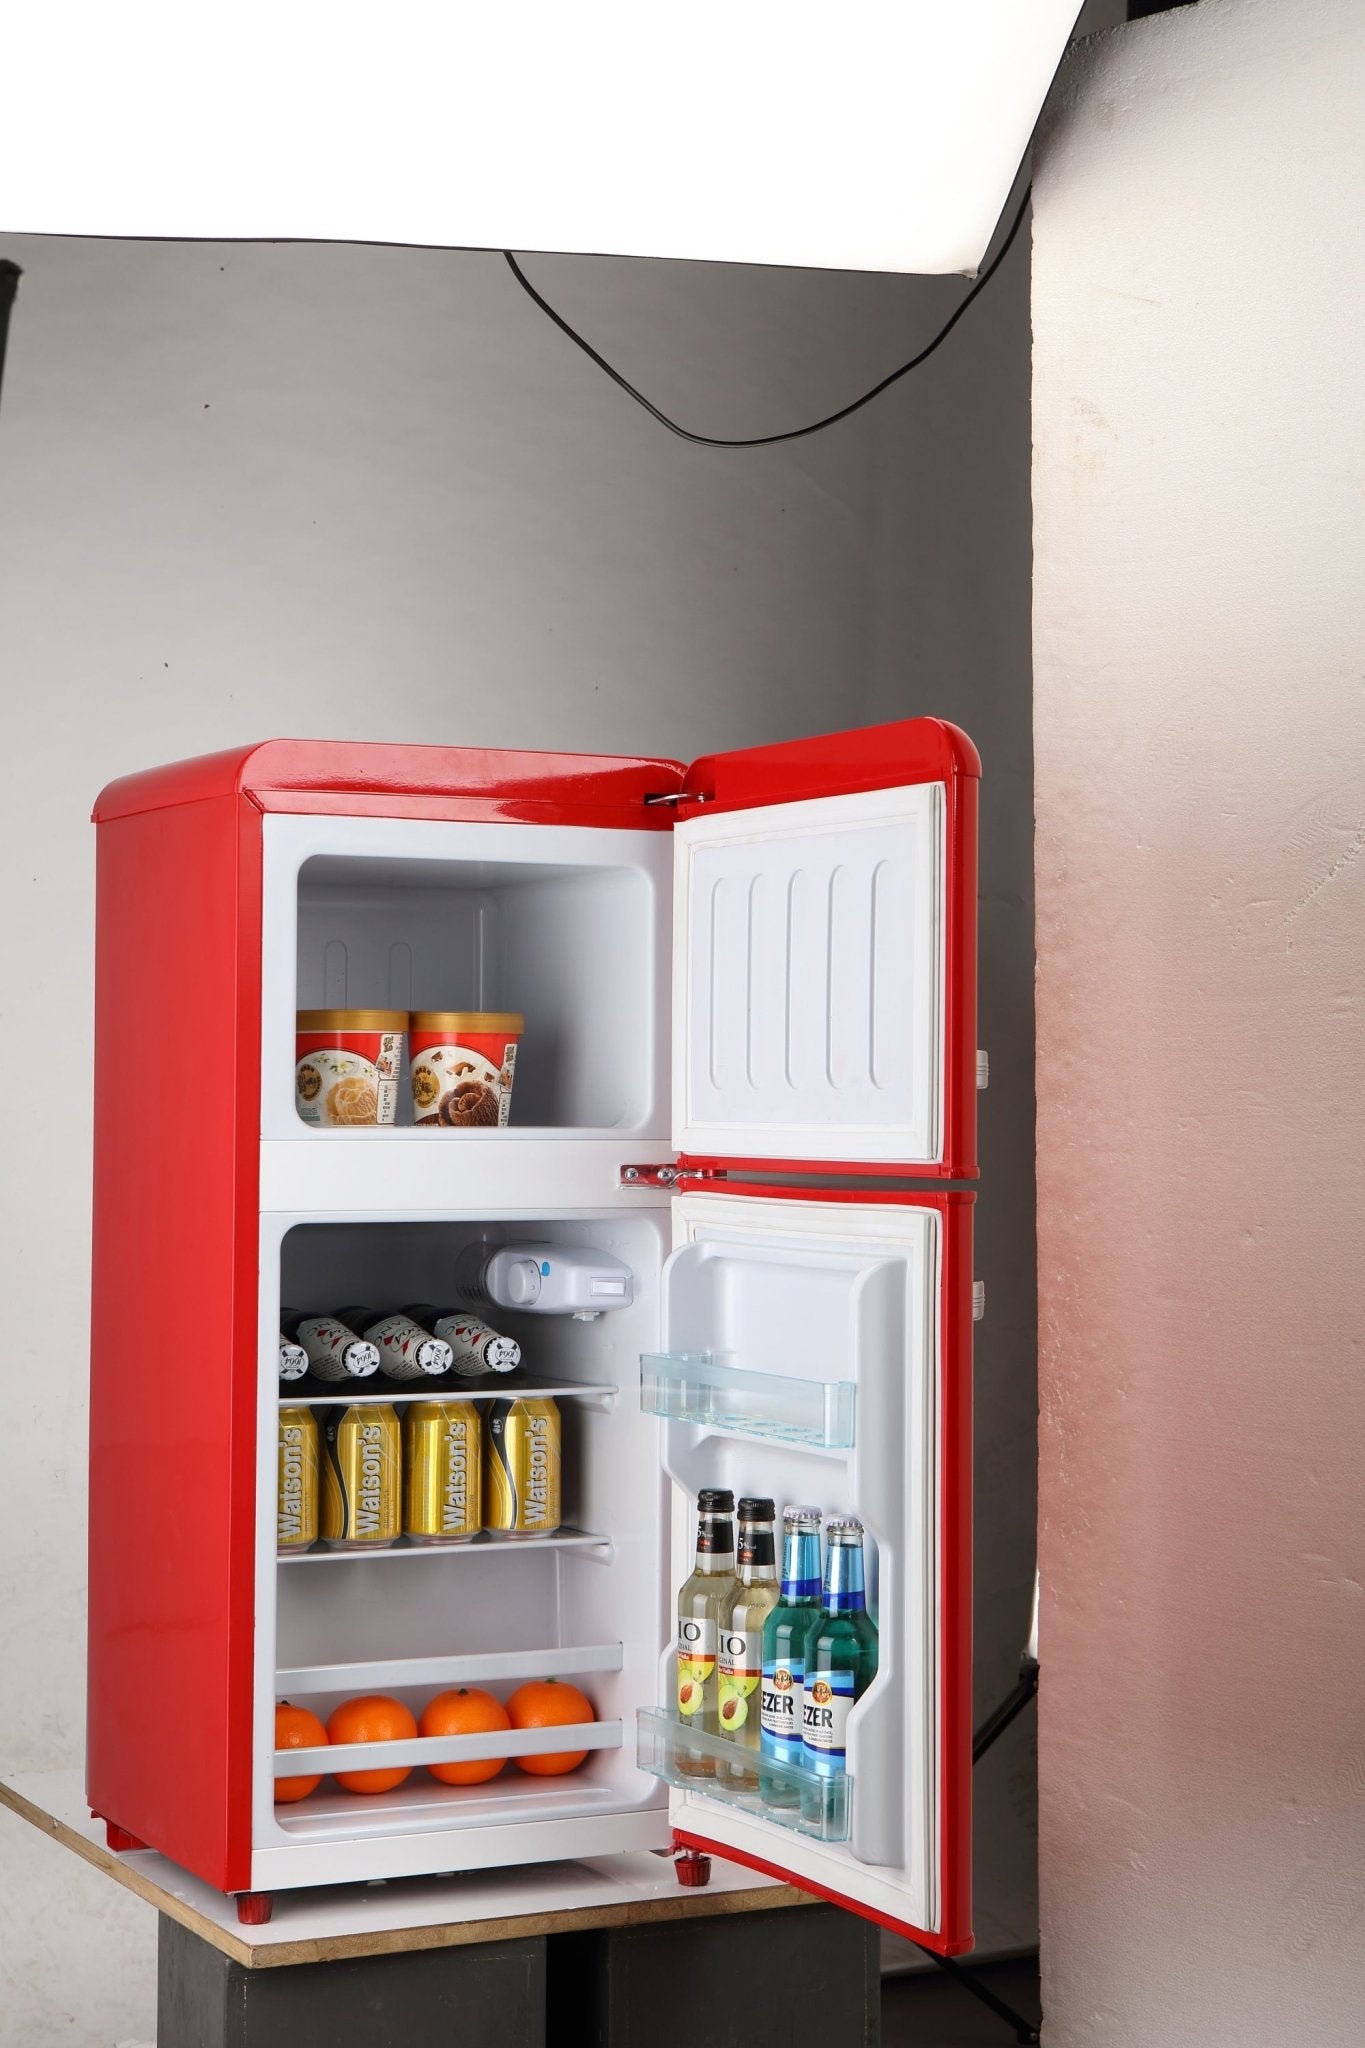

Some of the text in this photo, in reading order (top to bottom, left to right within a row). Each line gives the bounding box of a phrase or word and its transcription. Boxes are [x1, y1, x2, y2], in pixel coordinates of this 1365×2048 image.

[284, 1357, 302, 1367] 1664
[356, 1351, 372, 1365] 1664
[432, 1347, 443, 1366] 1664
[498, 1349, 515, 1360] 1664
[278, 1427, 303, 1539] Watson's
[356, 1425, 382, 1536] Watson's
[443, 1421, 468, 1531] Watson's
[524, 1417, 548, 1526] Watson's
[720, 1631, 747, 1656] IO
[762, 1690, 794, 1716] EZER
